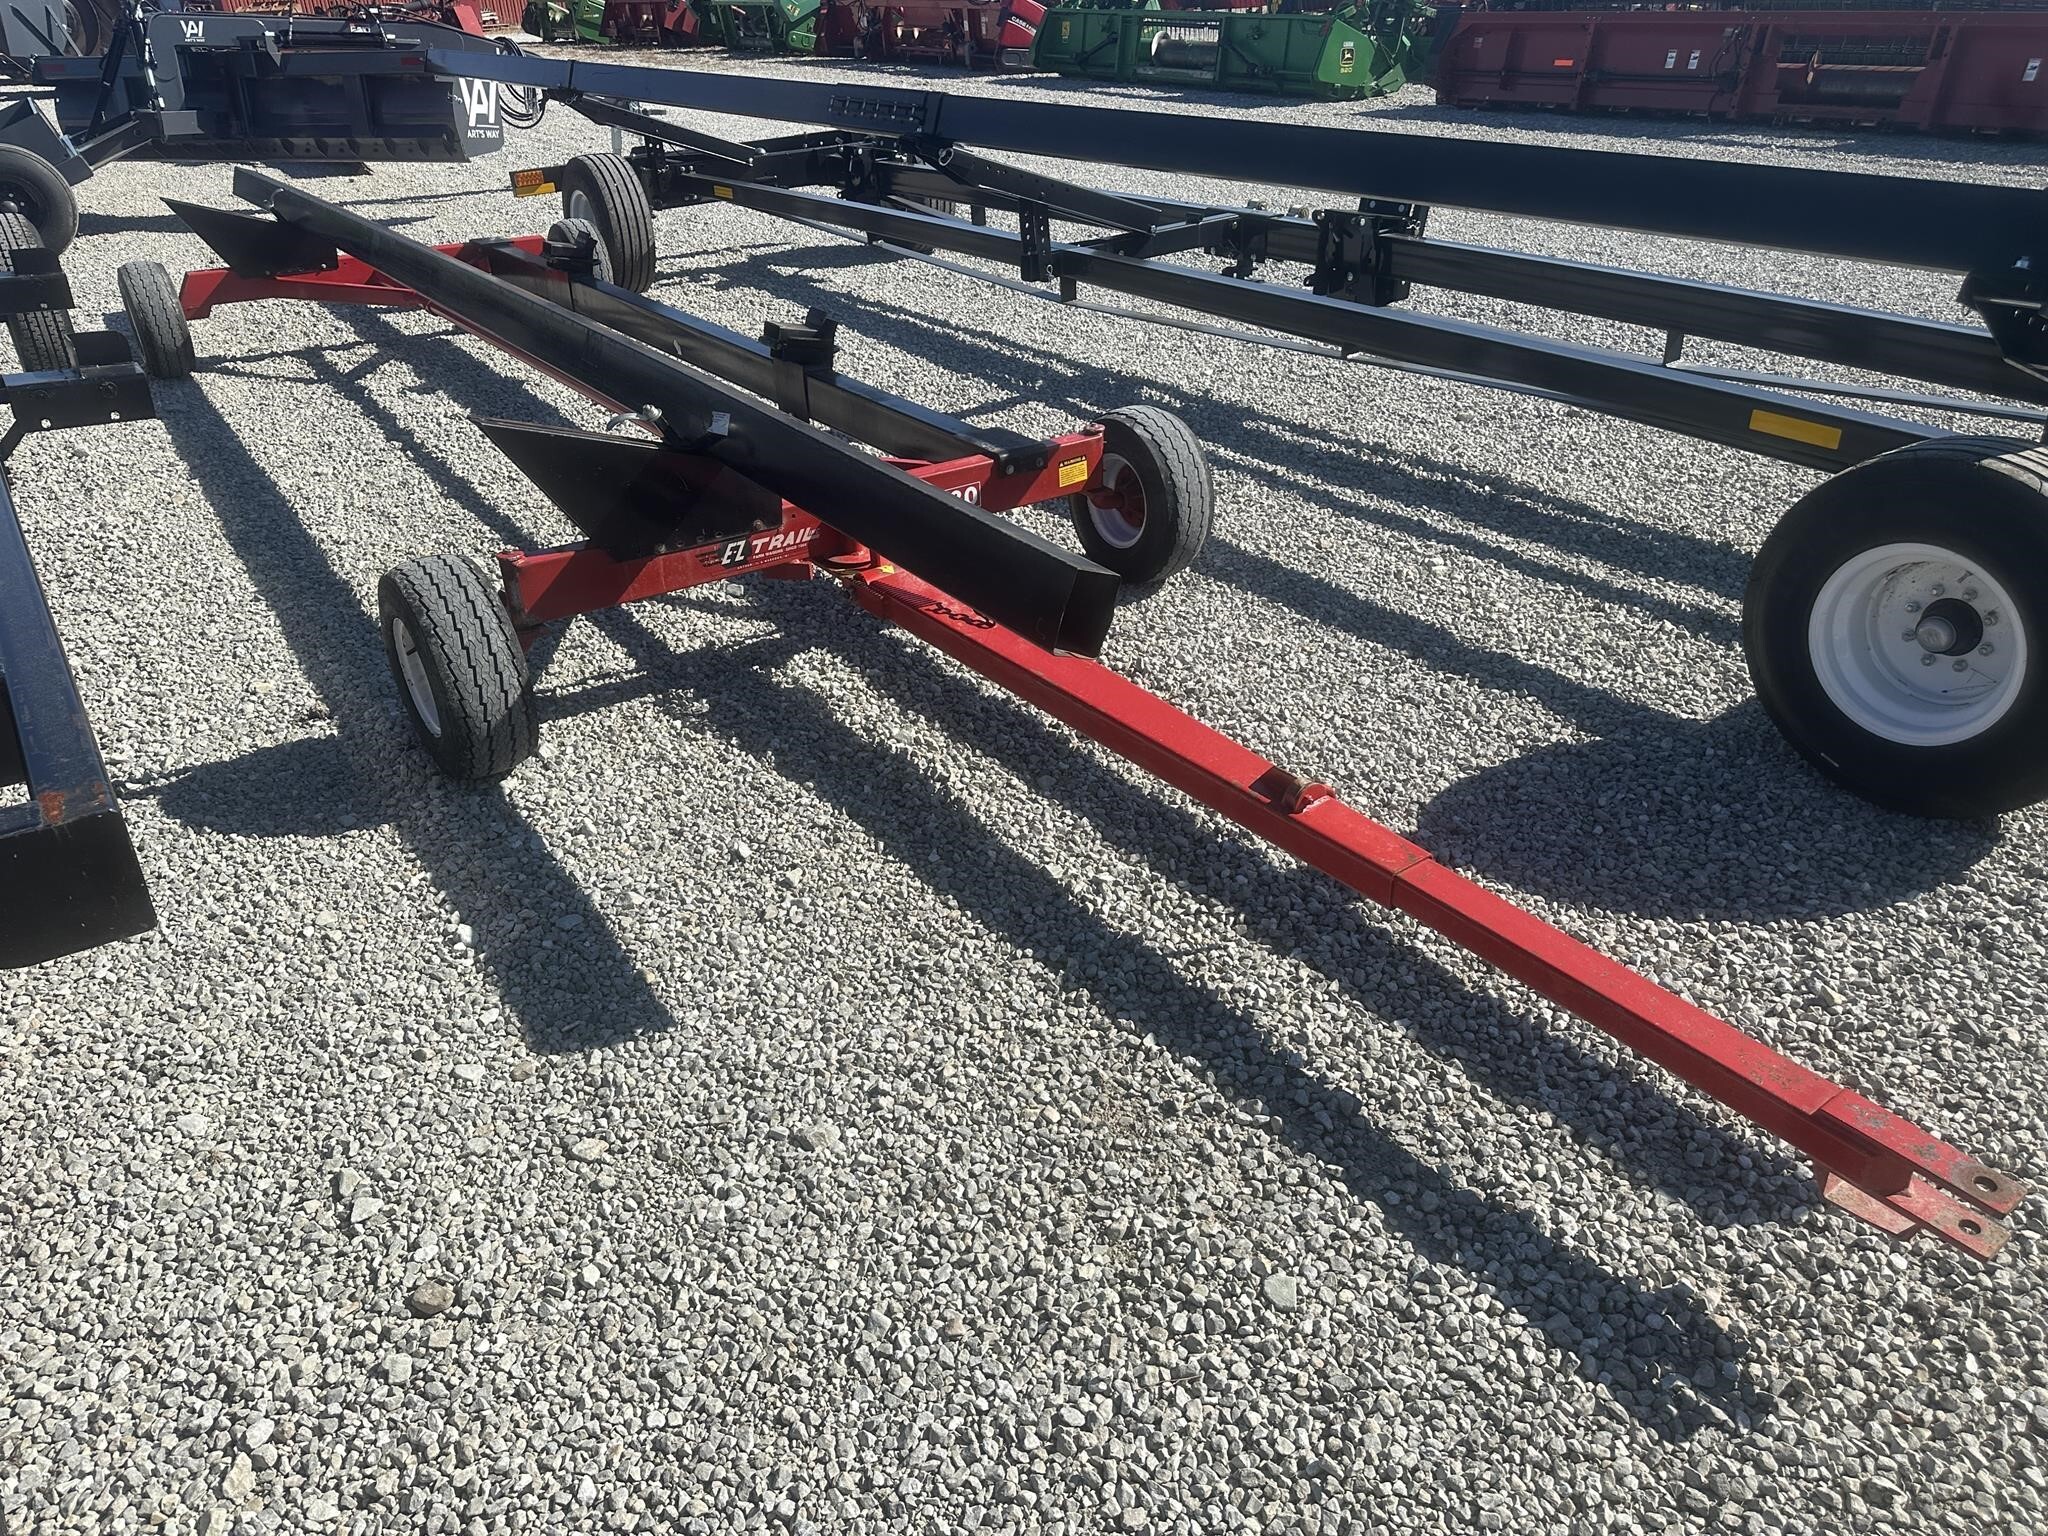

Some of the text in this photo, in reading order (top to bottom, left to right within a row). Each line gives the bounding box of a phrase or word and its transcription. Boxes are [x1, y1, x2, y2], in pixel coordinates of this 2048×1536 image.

[1011, 16, 1027, 27] CASE
[468, 129, 500, 138] ART'S WAY
[752, 527, 816, 553] TRAIL
